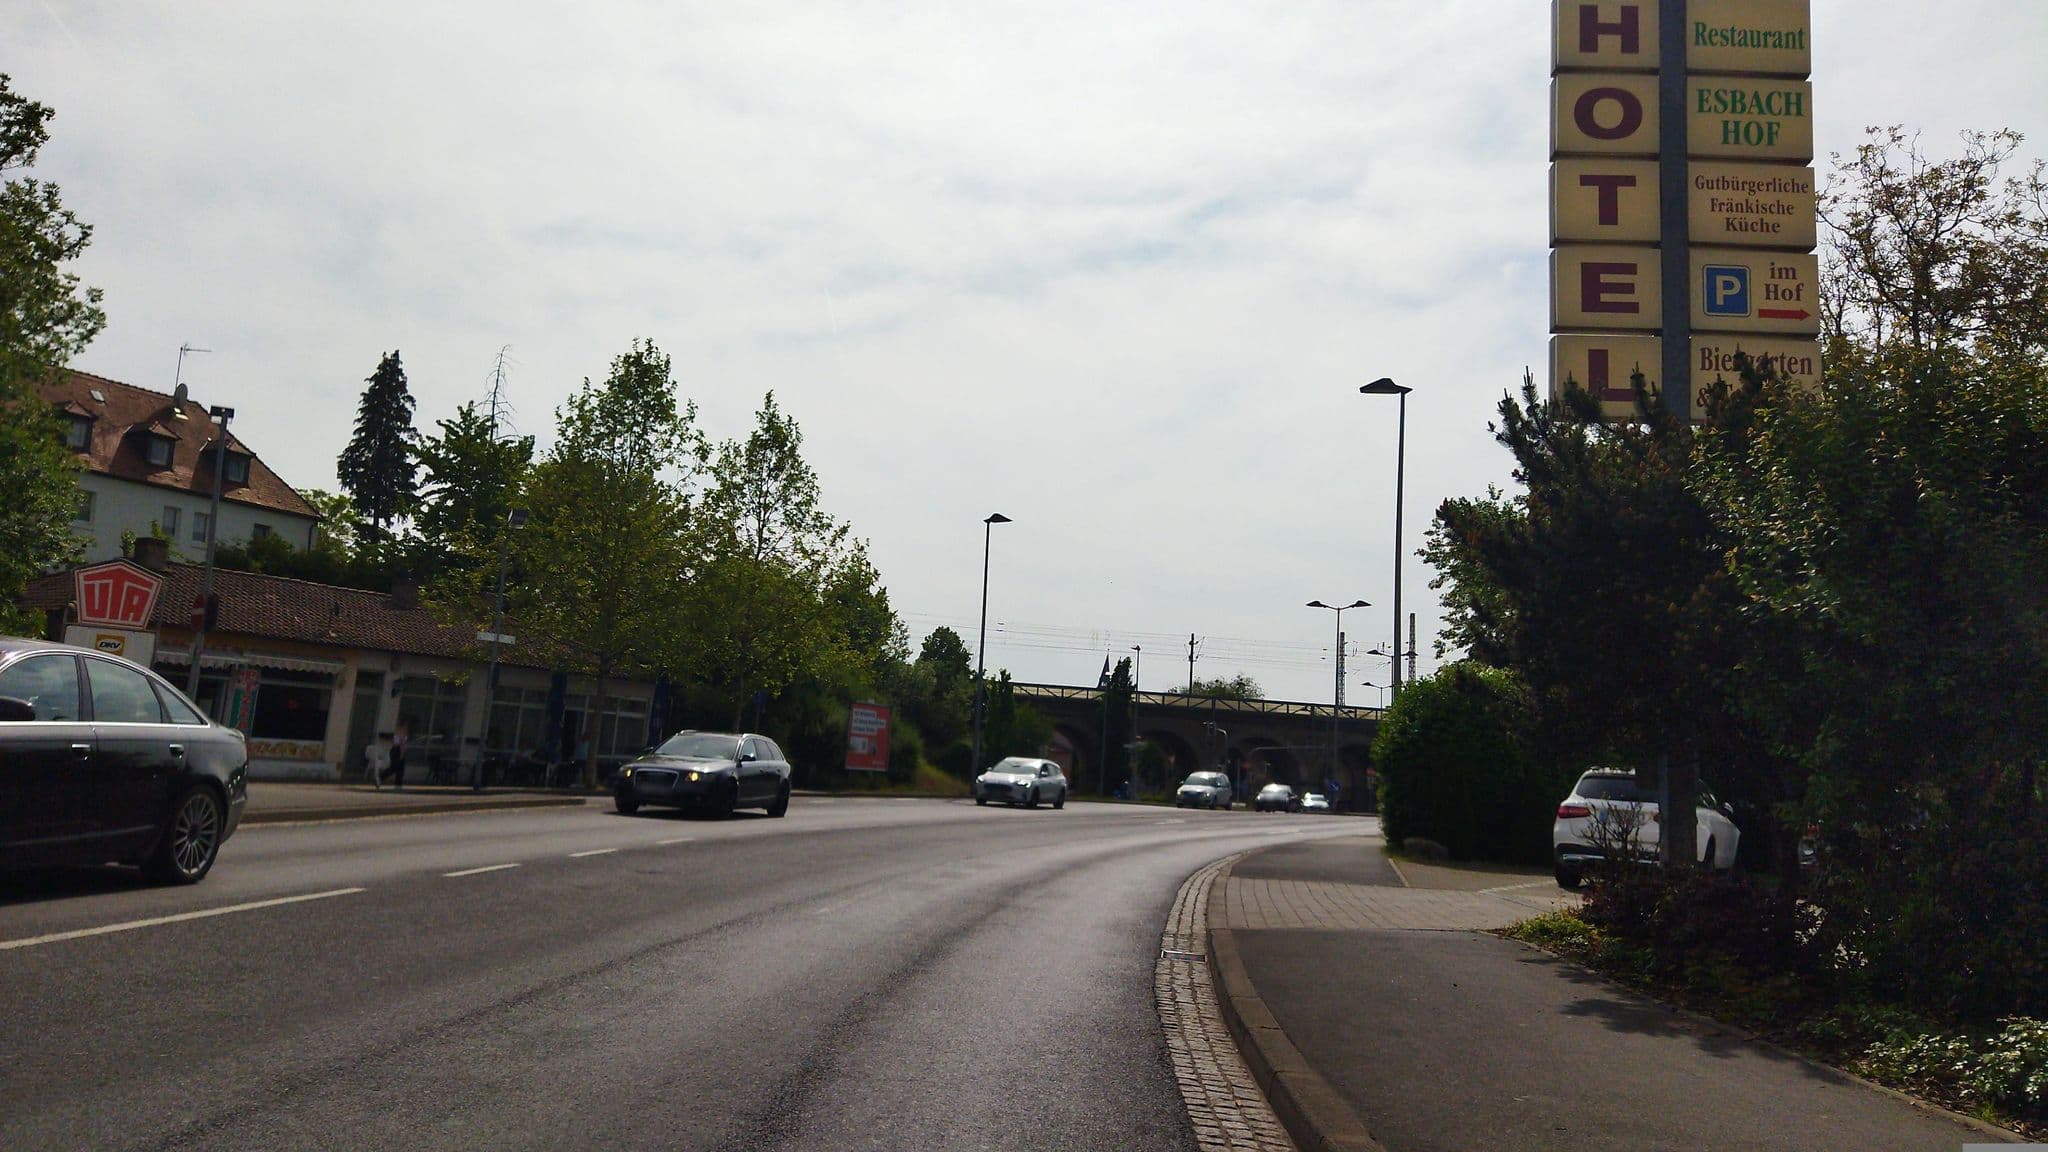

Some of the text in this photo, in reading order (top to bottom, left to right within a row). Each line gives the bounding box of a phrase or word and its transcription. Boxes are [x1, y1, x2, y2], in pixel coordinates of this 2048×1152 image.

[1693, 21, 1806, 50] Restaurant
[1696, 88, 1804, 117] ESBACH
[1720, 120, 1781, 146] HOF
[1694, 174, 1810, 196] Gutbürgerliche
[1573, 4, 1644, 403] HOTEL
[1709, 197, 1796, 216] Fränkische
[1724, 217, 1782, 234] Küche
[1769, 261, 1798, 280] im
[1715, 275, 1742, 306] P
[1763, 282, 1805, 302] Hof
[1699, 346, 1814, 376] Bierten
[82, 568, 154, 623] UTA
